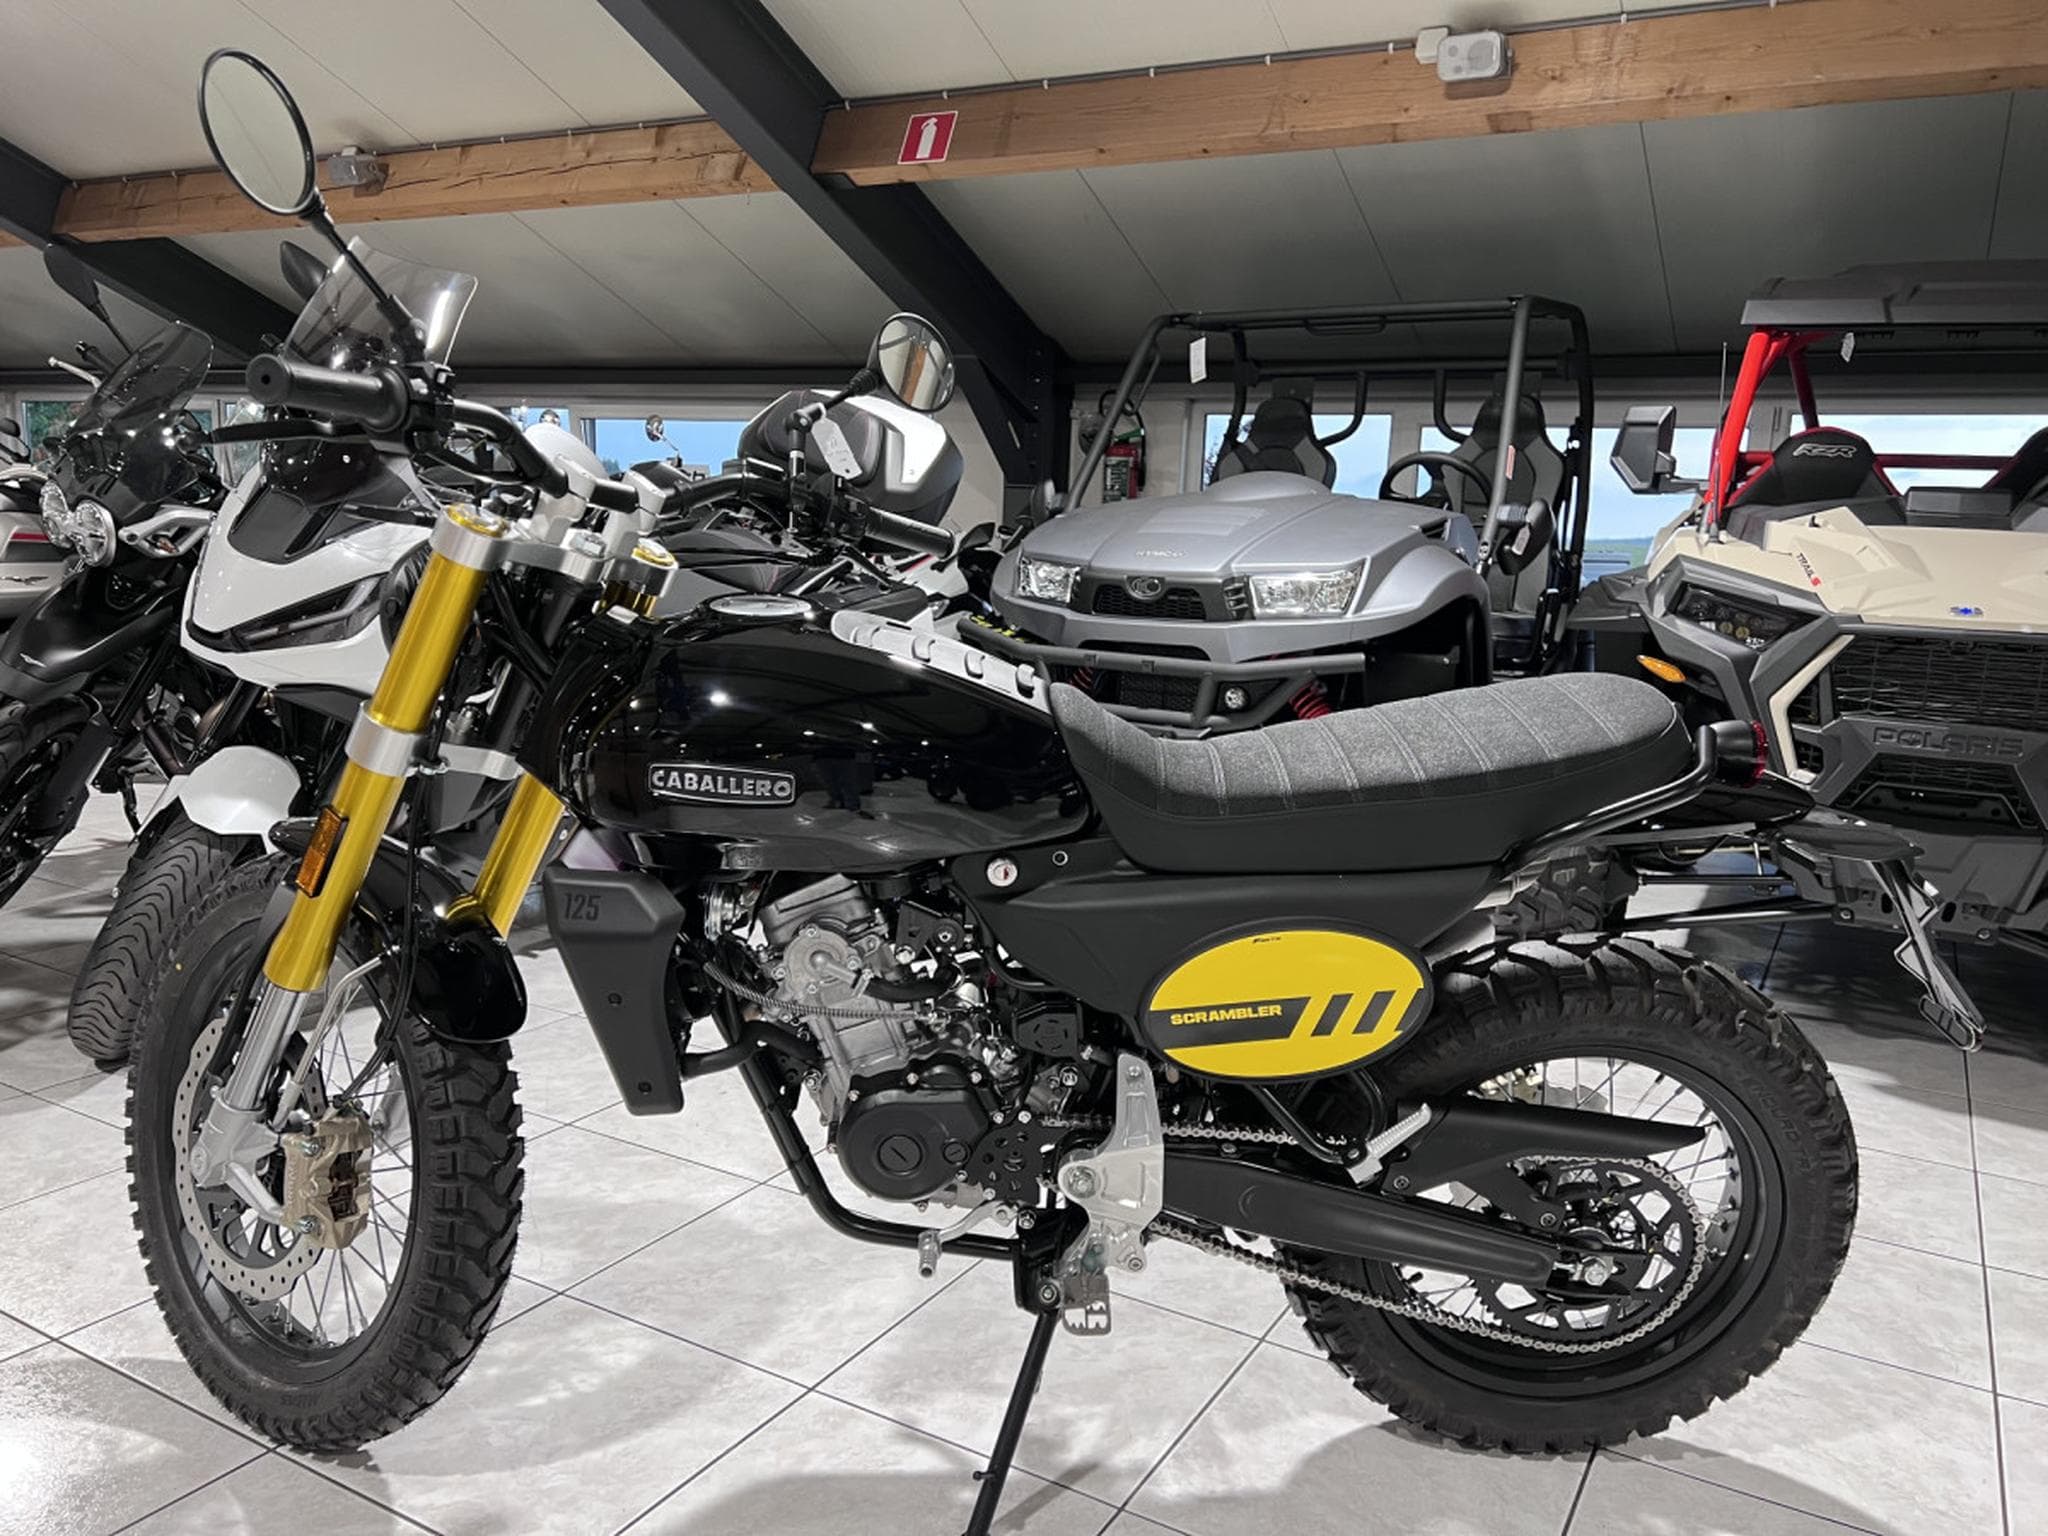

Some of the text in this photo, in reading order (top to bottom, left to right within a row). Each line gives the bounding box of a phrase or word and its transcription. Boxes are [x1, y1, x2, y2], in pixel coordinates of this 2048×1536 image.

[1793, 443, 1857, 458] RZR
[1873, 727, 2024, 757] POLARIS
[652, 770, 791, 798] CABALLERO
[564, 892, 602, 921] 125
[1170, 1004, 1283, 1026] SCRAMBLER
